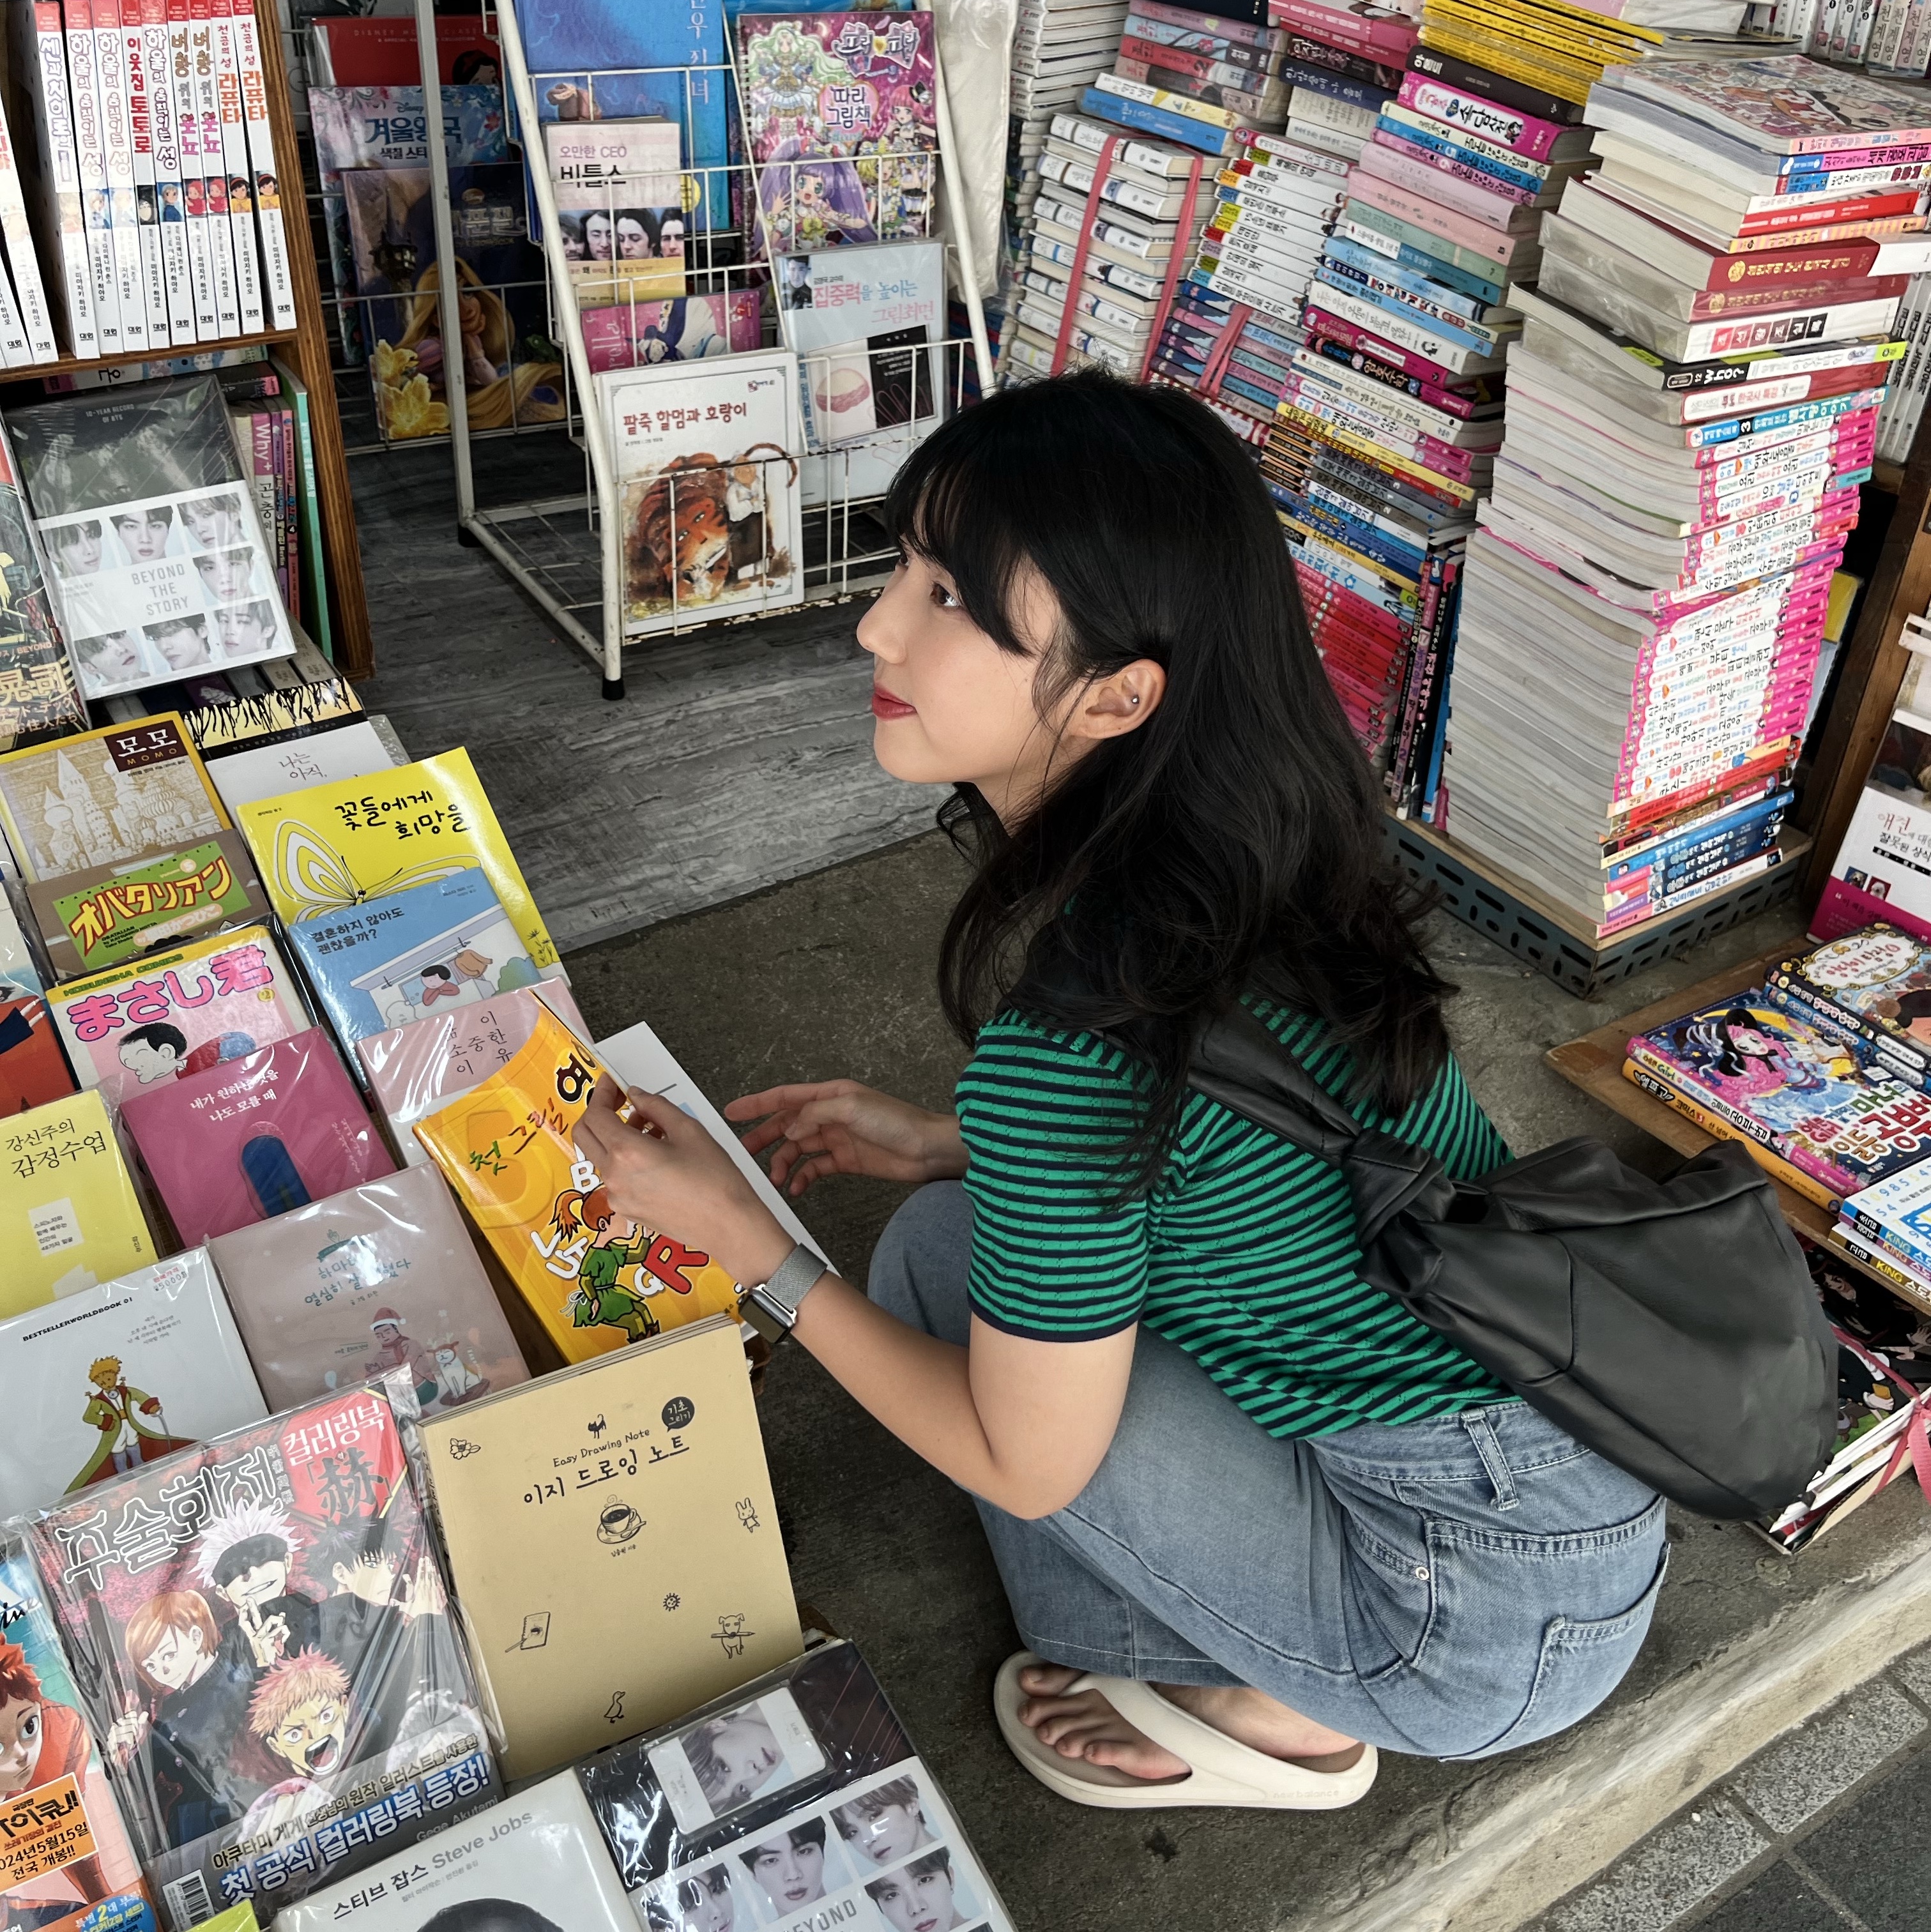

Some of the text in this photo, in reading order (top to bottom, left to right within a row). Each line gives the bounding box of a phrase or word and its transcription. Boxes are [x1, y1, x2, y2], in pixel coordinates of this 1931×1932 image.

[217, 24, 243, 123] 천공의 성 라퓨타
[240, 22, 268, 121] 천공의 성 라퓨타
[70, 34, 103, 176] 하울의 성
[98, 33, 119, 88] 하울의
[110, 151, 130, 174] 성
[127, 37, 153, 153] 이웃집 토토로
[144, 29, 166, 84] 하울의
[157, 146, 177, 169] 성
[171, 27, 199, 155] 벼랑 위의 포뇨
[194, 26, 221, 153] 벼랑 위의 포뇨
[830, 87, 866, 104] 따라
[826, 105, 871, 128] 그림책
[560, 146, 627, 159] 오만한 CEO
[560, 164, 627, 188] 비틀스
[813, 280, 918, 309] 집중력을 높이는
[1361, 358, 1411, 390] 암호수학
[102, 413, 123, 424] OF BTS
[623, 402, 747, 435] 팥죽 할멈과 호랑이
[132, 563, 186, 586] BEYOND
[149, 583, 178, 598] THE
[146, 597, 190, 617] STORY
[116, 729, 177, 758] 모모
[127, 748, 177, 766] MOMO
[279, 752, 311, 768] 나는
[335, 790, 434, 831] 꽃들에게
[395, 804, 471, 840] 희망을
[1879, 831, 1910, 853] 잘못된
[68, 855, 233, 957] オバタリアン
[312, 908, 404, 943] 결혼하지 않아도
[317, 929, 378, 956] 괜찮을까?
[137, 954, 184, 973] COMICS
[66, 945, 274, 1042] まさし君
[480, 1010, 498, 1026] 이
[190, 1093, 215, 1110] 내가
[209, 1088, 277, 1122] 나도 모를 때
[5, 1118, 75, 1152] 강신주의
[11, 1131, 107, 1179] 감정수업
[469, 1140, 508, 1176] 첫
[570, 1160, 600, 1194] B
[1882, 1242, 1908, 1263] KING
[1885, 1231, 1912, 1254] KING
[645, 1233, 709, 1295] R
[1875, 1259, 1903, 1283] KING
[305, 1281, 344, 1307] 열심히
[22, 1300, 122, 1342] BESTSELLERWORLDBOOK
[666, 1400, 689, 1416] 기초
[668, 1412, 692, 1425] 그리기
[284, 1399, 386, 1466] 컬러링북
[553, 1427, 651, 1468] Easy Drawing Note
[523, 1434, 691, 1505] 이지 드로잉 노트
[55, 1447, 283, 1590] 주술회전
[212, 1728, 480, 1869] 아쿠타미 게게 선생님의 원작 일러스트를 사용한
[452, 1795, 500, 1827] Akutami
[4, 1820, 63, 1851] 쓰레기장의 결전
[220, 1756, 491, 1906] 첫 공식 컬러링북 등장!
[11, 1843, 76, 1882] 전국 개봉!!
[333, 1812, 533, 1920] 스티브 잡스 Steve Jobs
